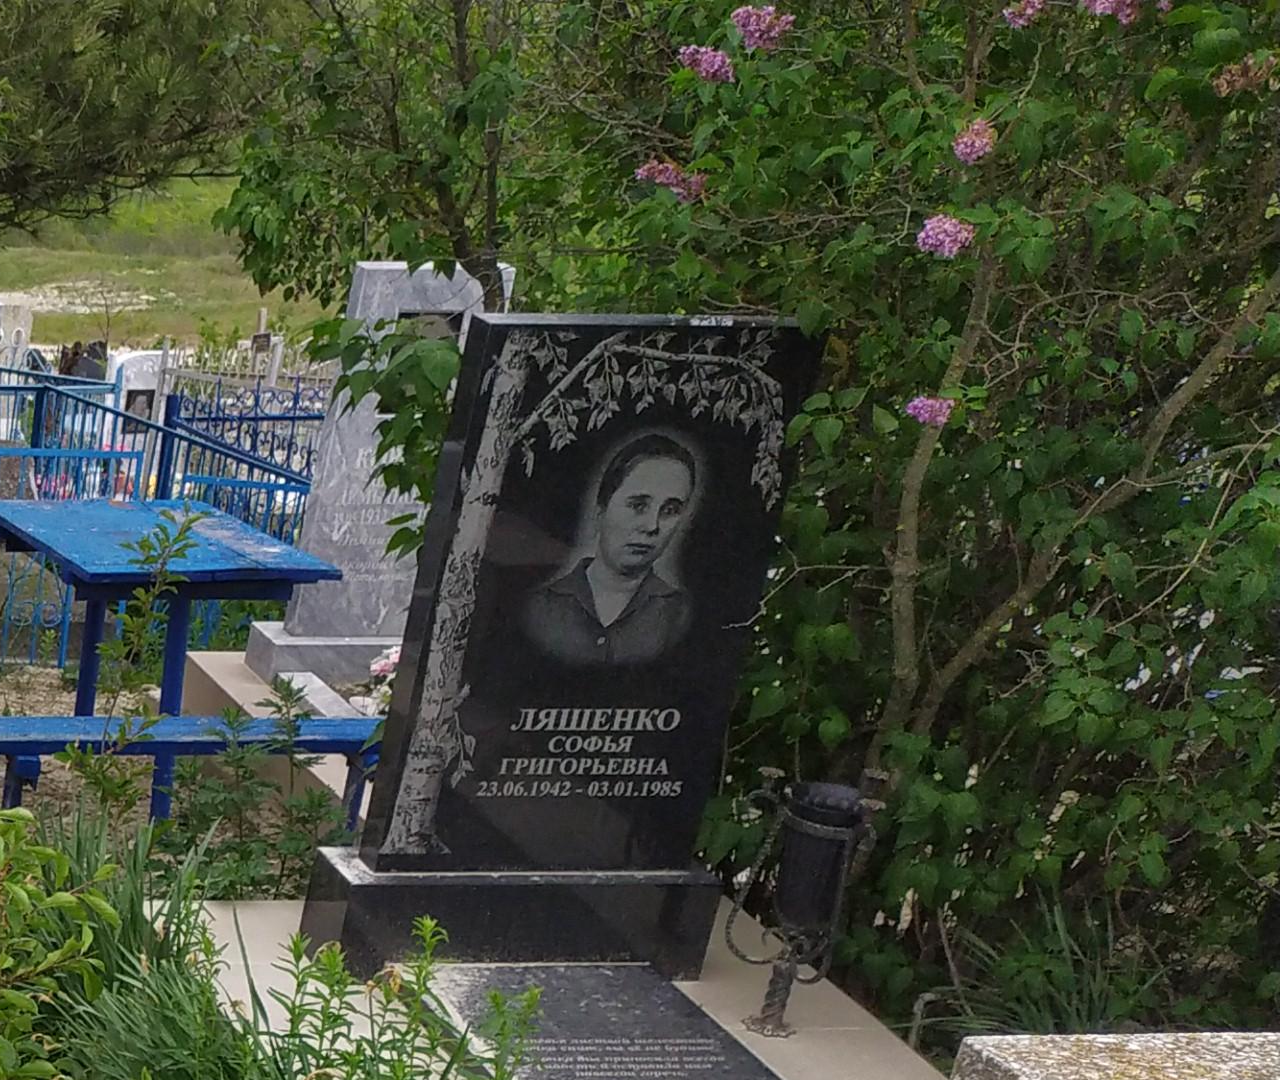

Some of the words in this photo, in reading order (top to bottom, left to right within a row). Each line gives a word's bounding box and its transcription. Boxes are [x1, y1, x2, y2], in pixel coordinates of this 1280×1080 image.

[509, 707, 681, 732] ЛЯШЕНКО
[547, 735, 634, 753] СОФЬЯ
[498, 757, 670, 776] ГРИГОРЬЕВНА
[475, 780, 571, 798] 23.06.1942
[587, 780, 684, 798] 03.01.1985
